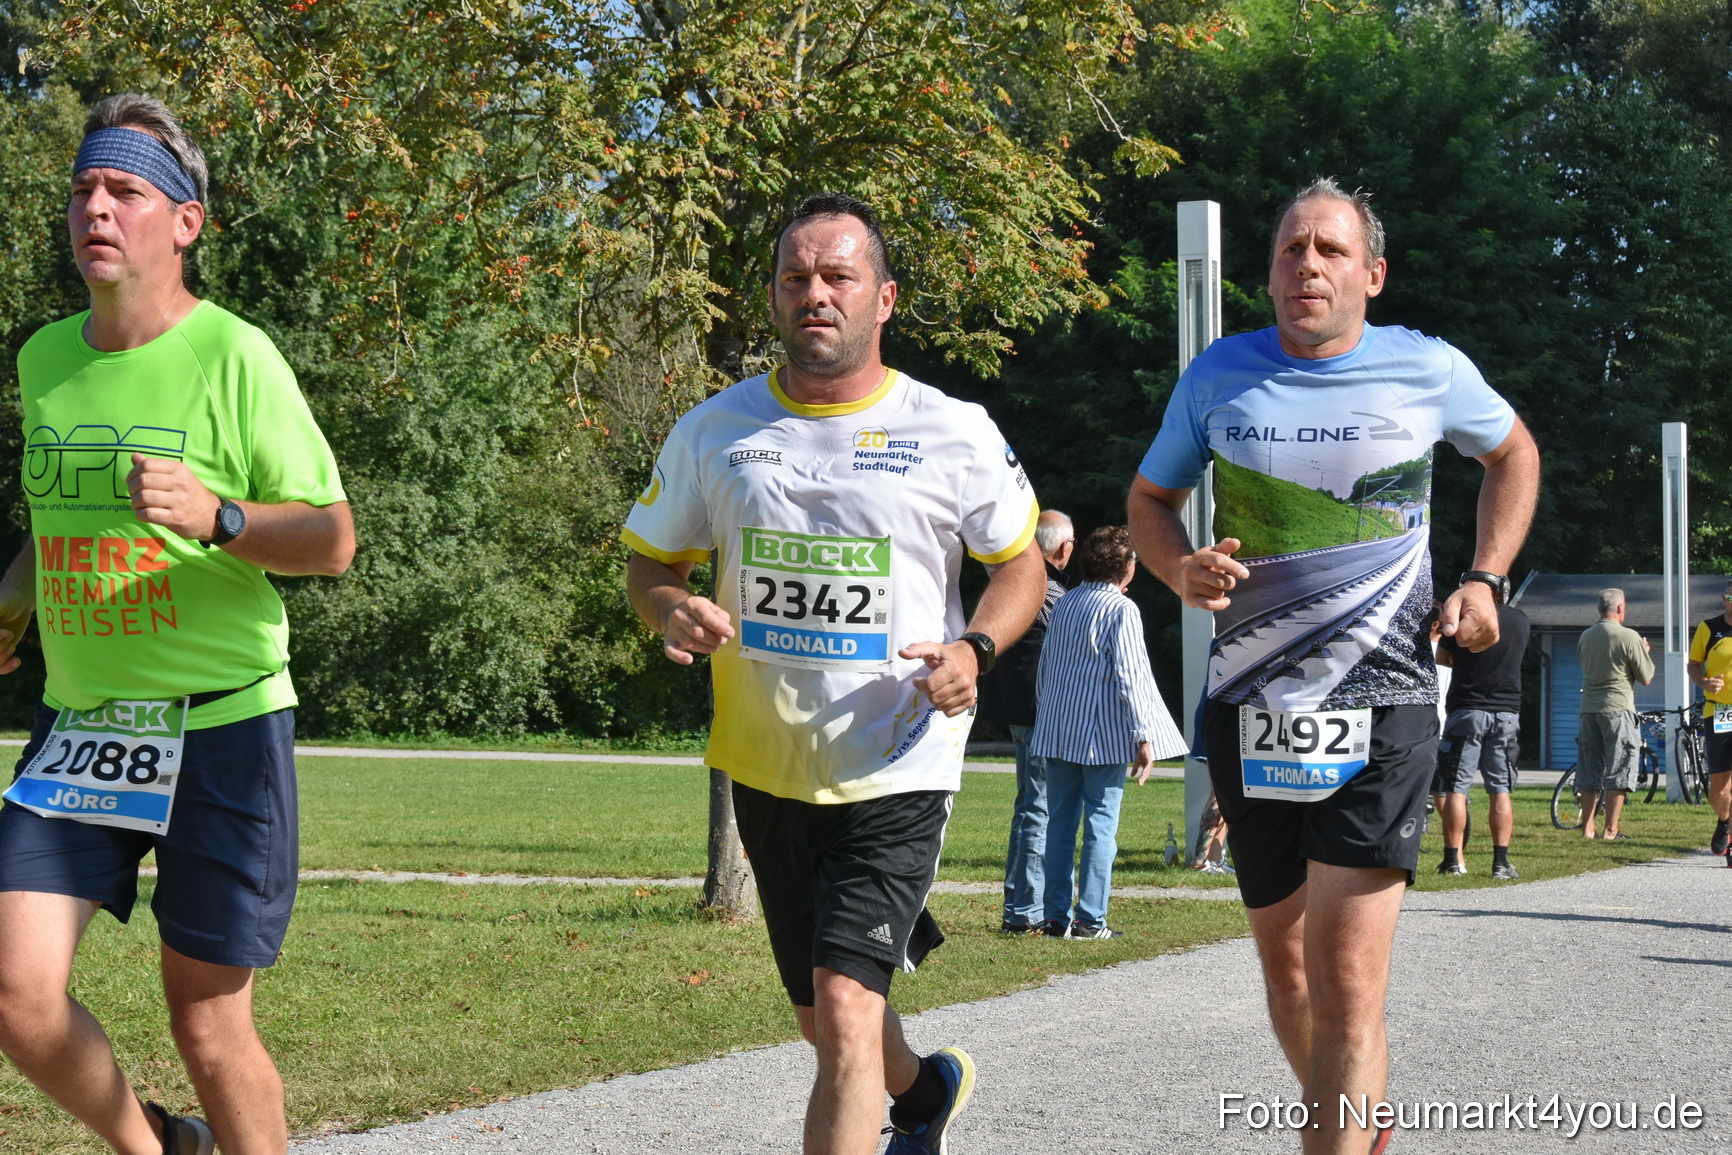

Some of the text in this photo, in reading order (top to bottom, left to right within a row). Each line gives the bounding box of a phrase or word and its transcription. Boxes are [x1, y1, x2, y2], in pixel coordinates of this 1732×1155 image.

[857, 431, 917, 449] 20 JAHRE
[1226, 426, 1360, 442] RAIL.ONE
[729, 450, 782, 463] BOCK
[855, 450, 924, 465] Neumarkter
[852, 462, 909, 477] Stadtlauf
[49, 503, 61, 511] und
[39, 536, 169, 573] MERZ
[751, 532, 879, 572] BOCK
[42, 575, 173, 606] PREMIUM
[755, 576, 871, 624] 2342
[45, 605, 178, 637] REISEN
[765, 630, 858, 656] RONALD
[908, 707, 936, 741] Septemb
[1254, 712, 1350, 755] 2492
[1356, 721, 1364, 729] C
[41, 738, 161, 785] 2088
[165, 750, 174, 758] D
[1262, 766, 1339, 785] THOMAS
[47, 787, 118, 810] JÖRG
[867, 931, 893, 945] adidas
